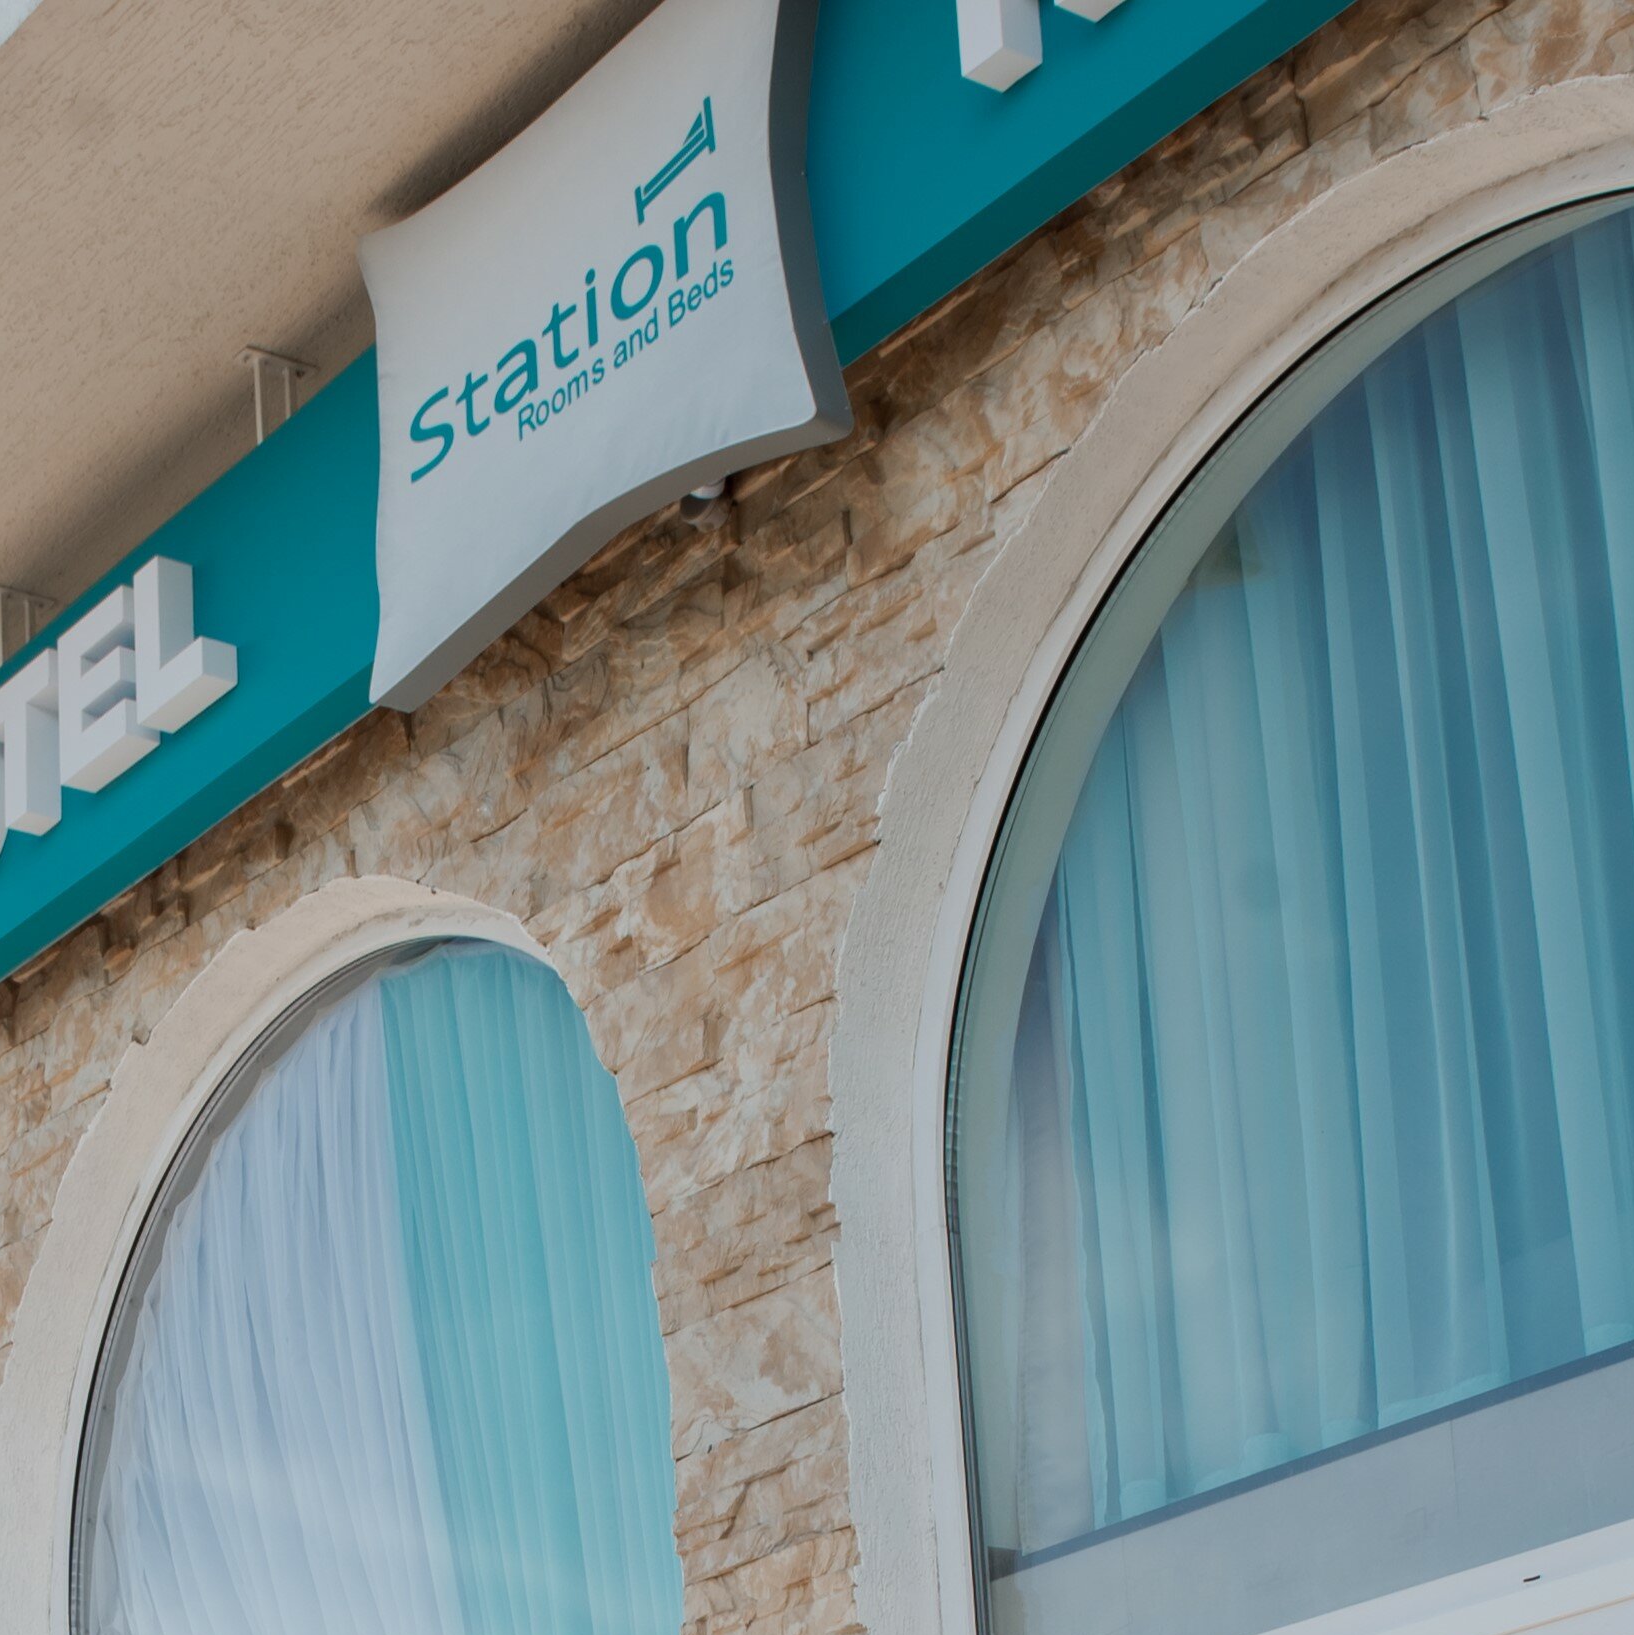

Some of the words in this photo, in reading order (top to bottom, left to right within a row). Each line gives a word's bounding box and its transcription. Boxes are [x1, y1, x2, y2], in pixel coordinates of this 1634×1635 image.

[410, 192, 727, 483] Station
[518, 357, 605, 441] Rooms
[613, 307, 659, 368] and
[668, 258, 734, 328] Beds
